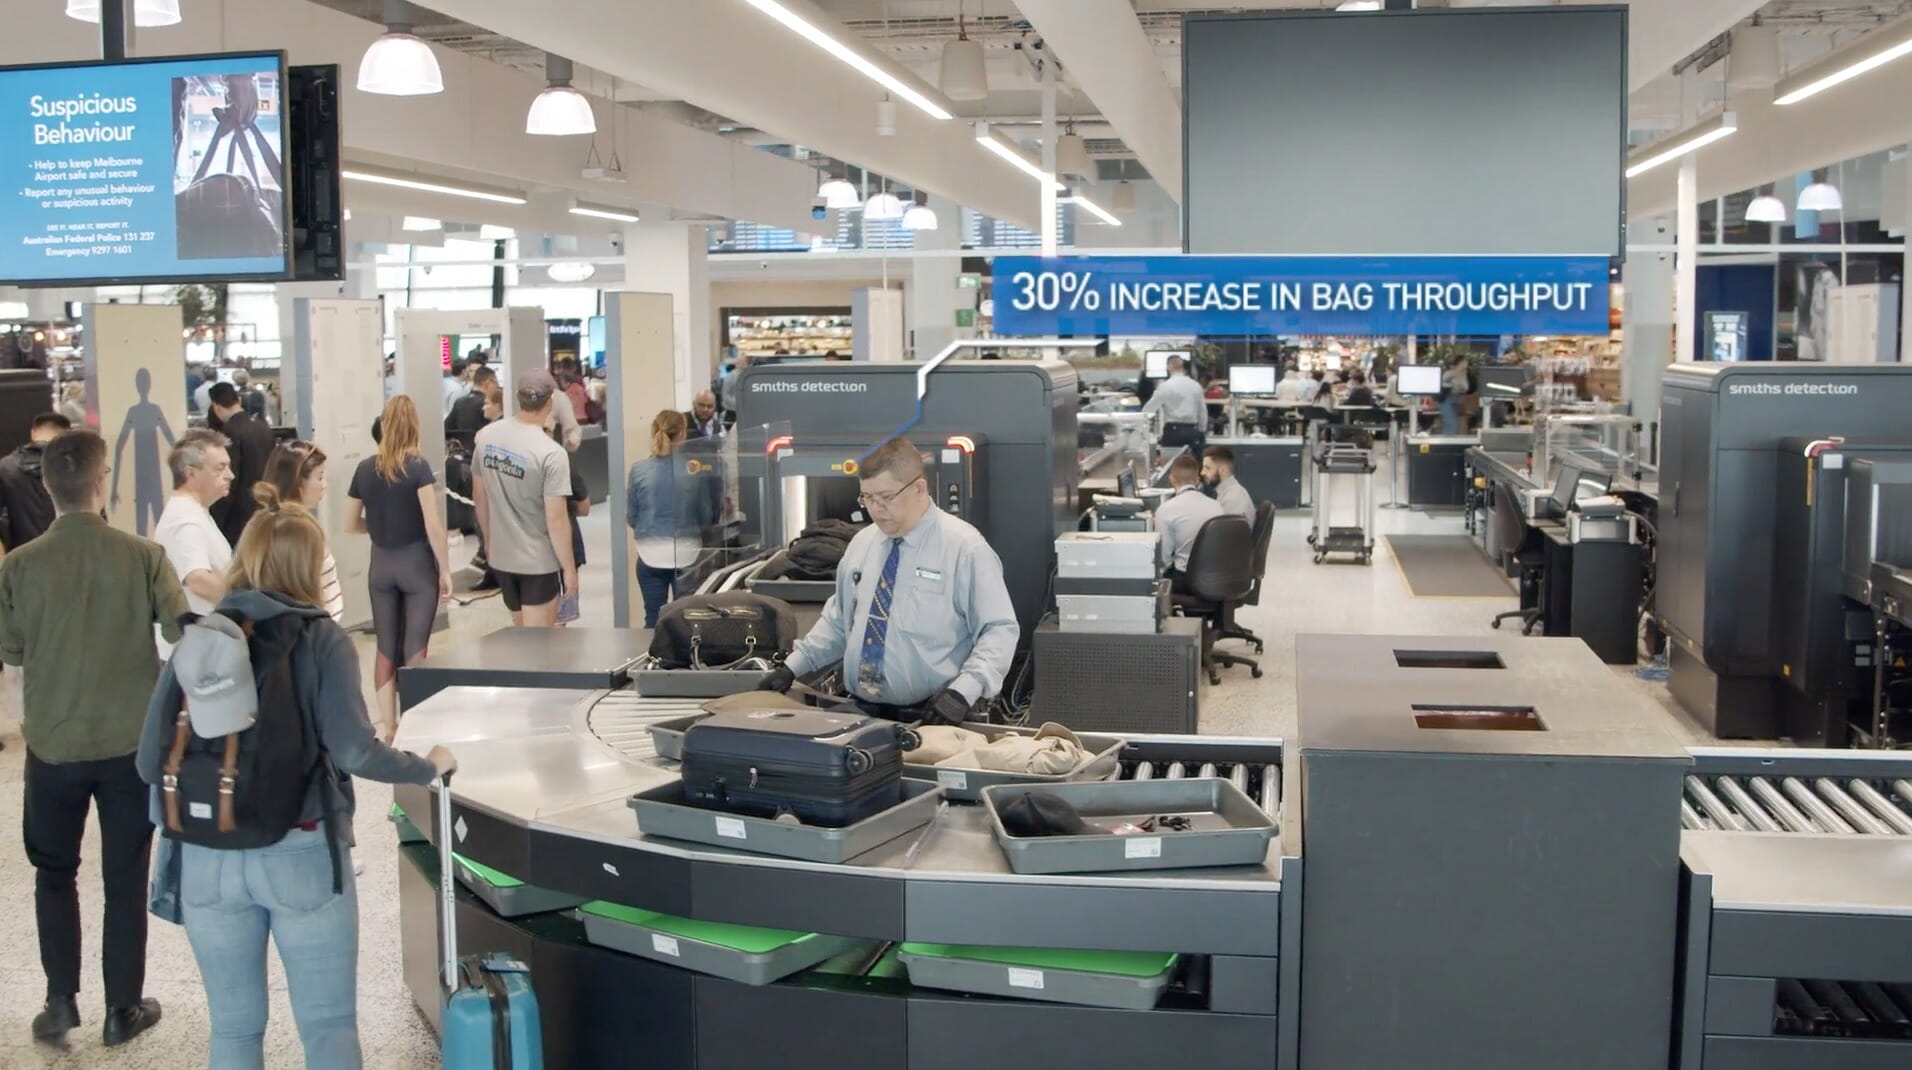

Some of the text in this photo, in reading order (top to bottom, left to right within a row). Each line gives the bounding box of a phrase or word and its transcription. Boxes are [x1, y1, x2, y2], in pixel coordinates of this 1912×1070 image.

[30, 92, 137, 122] Suspicious
[34, 121, 136, 144] Behaviour
[35, 157, 143, 171] Help to keep Melbourne
[35, 169, 138, 183] Airport safe and secure
[25, 184, 155, 199] Report any unusual behaviour
[42, 197, 134, 209] or suspicious activity
[23, 236, 64, 245] Australian
[64, 234, 96, 243] Federal
[97, 233, 122, 242] Police
[124, 233, 138, 241] 131
[46, 245, 132, 258] Emergency 9297 1601
[752, 381, 867, 392] smiths detection
[1730, 383, 1858, 394] smiths detection
